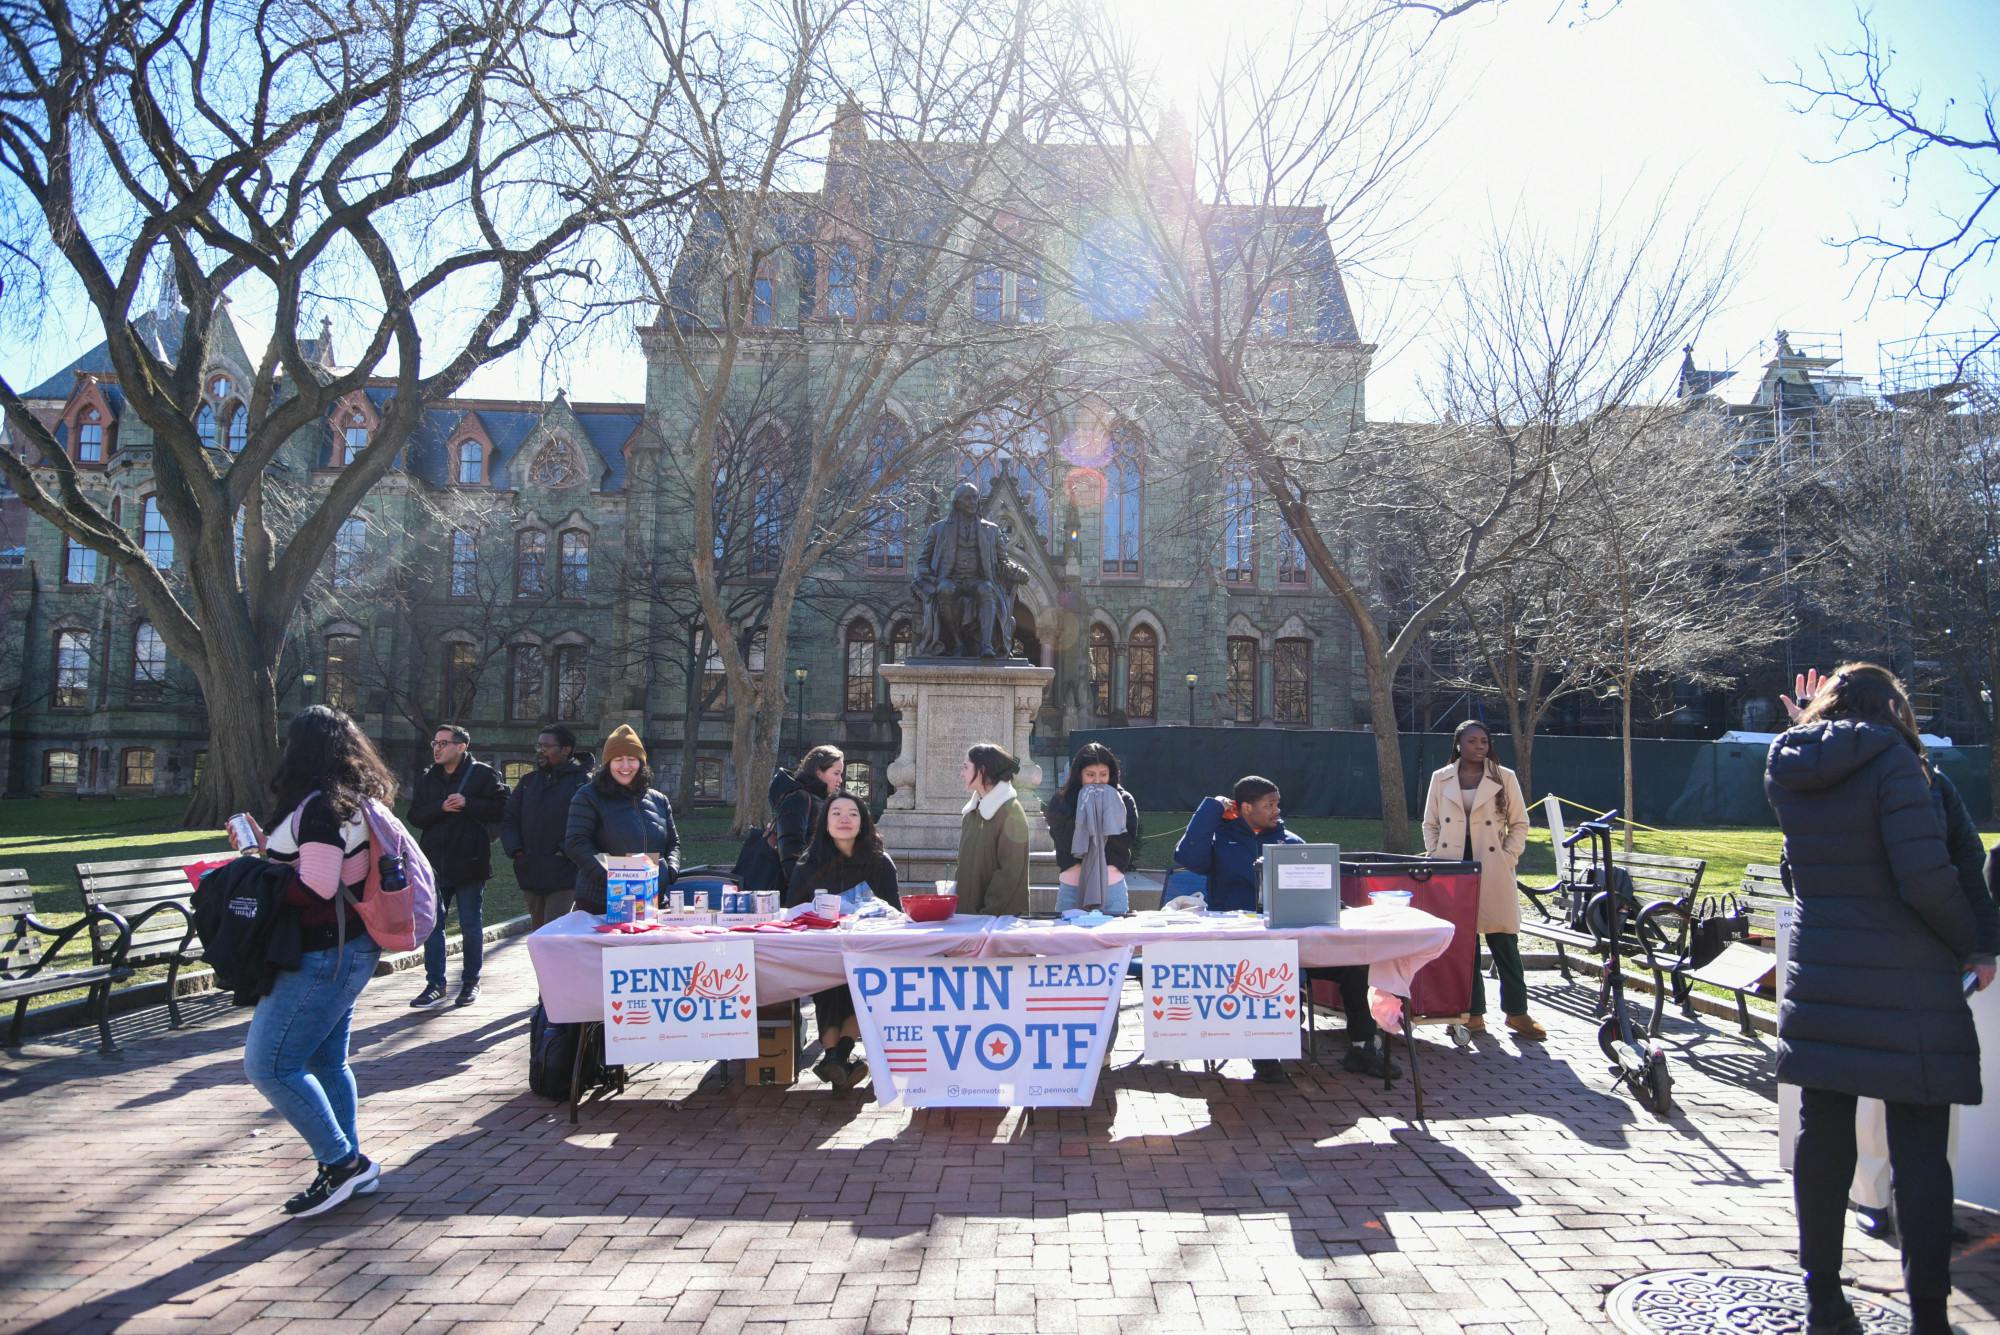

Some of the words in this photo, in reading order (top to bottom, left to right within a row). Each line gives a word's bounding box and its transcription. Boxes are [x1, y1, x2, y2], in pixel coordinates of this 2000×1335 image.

[1731, 931, 1741, 939] THE
[610, 966, 694, 994] PENN
[853, 965, 1013, 1012] PENN
[1151, 964, 1237, 989] PENN
[627, 999, 647, 1009] THE
[651, 996, 737, 1023] VOTE
[1168, 995, 1190, 1005] THE
[1193, 994, 1281, 1020] VOTE
[884, 1025, 923, 1042] THE
[932, 1023, 1097, 1071] VOTE
